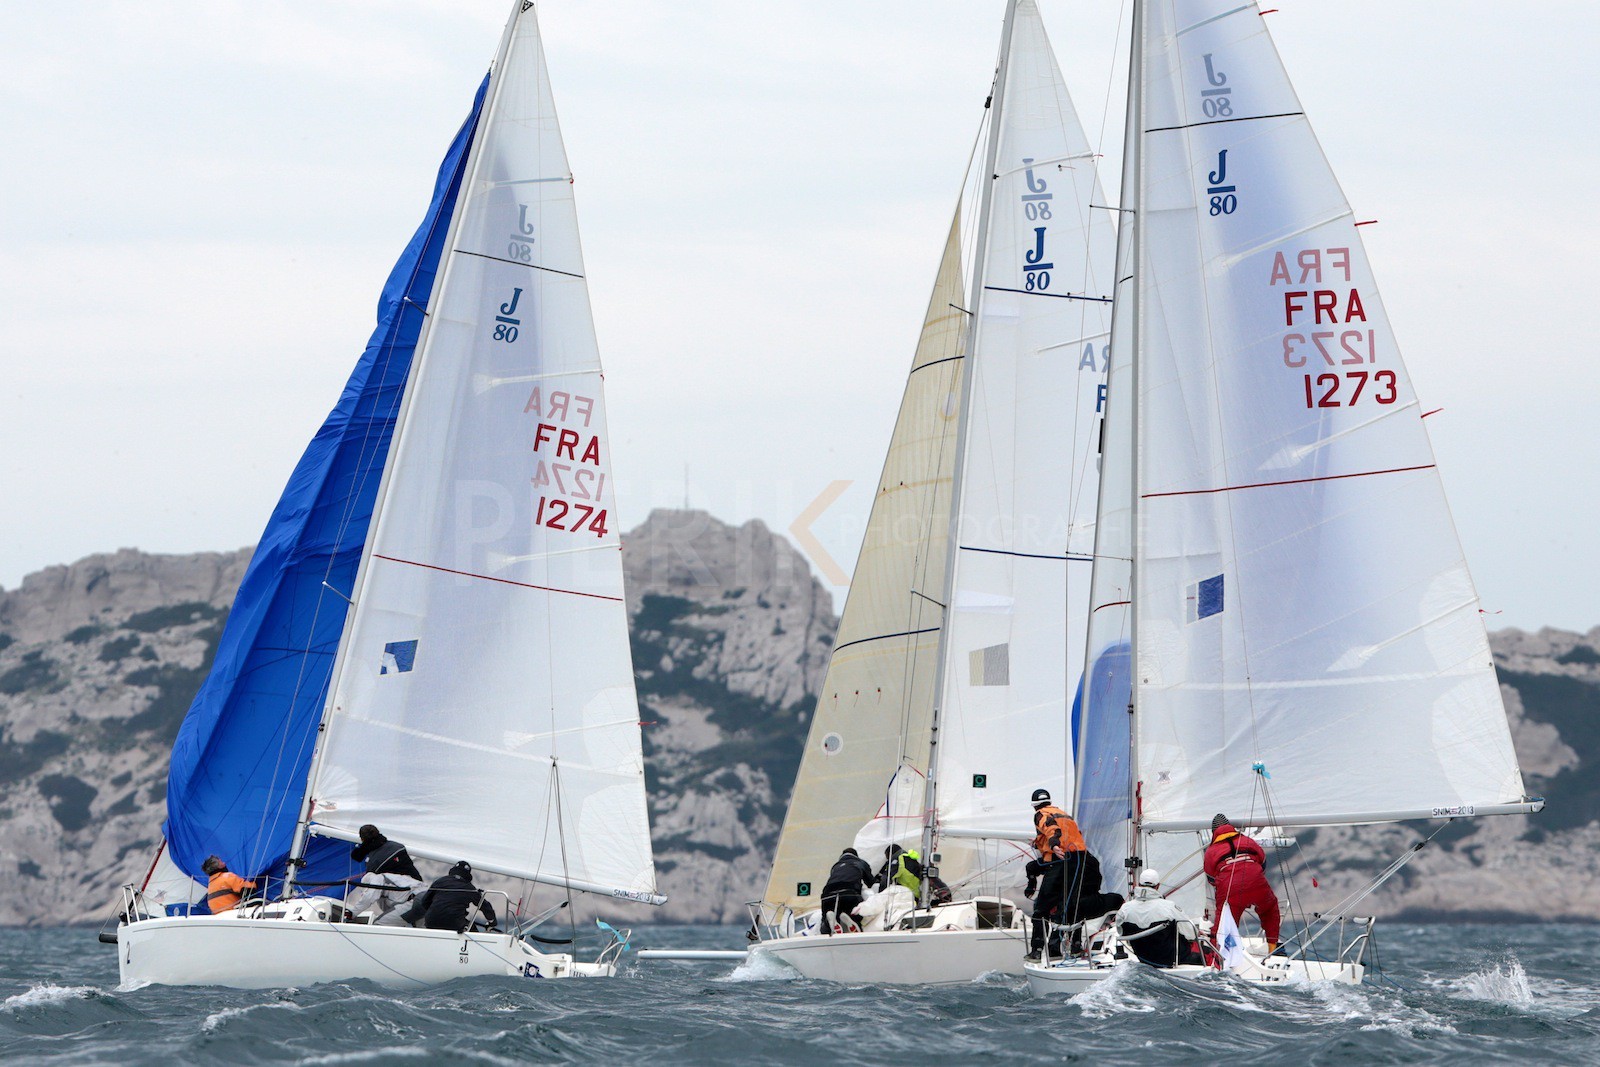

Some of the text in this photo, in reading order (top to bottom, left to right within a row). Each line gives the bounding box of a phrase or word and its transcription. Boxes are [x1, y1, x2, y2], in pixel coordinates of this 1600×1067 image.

[1208, 149, 1228, 185] J
[1210, 194, 1237, 217] 80
[1026, 227, 1047, 263] J
[1025, 271, 1051, 292] 80
[500, 287, 523, 316] J
[1285, 288, 1367, 326] FRA
[492, 324, 519, 344] 80
[1304, 370, 1397, 409] 1273
[533, 423, 601, 466] FRA
[535, 496, 609, 538] 1274
[459, 956, 469, 964] 80
[460, 940, 468, 952] J
